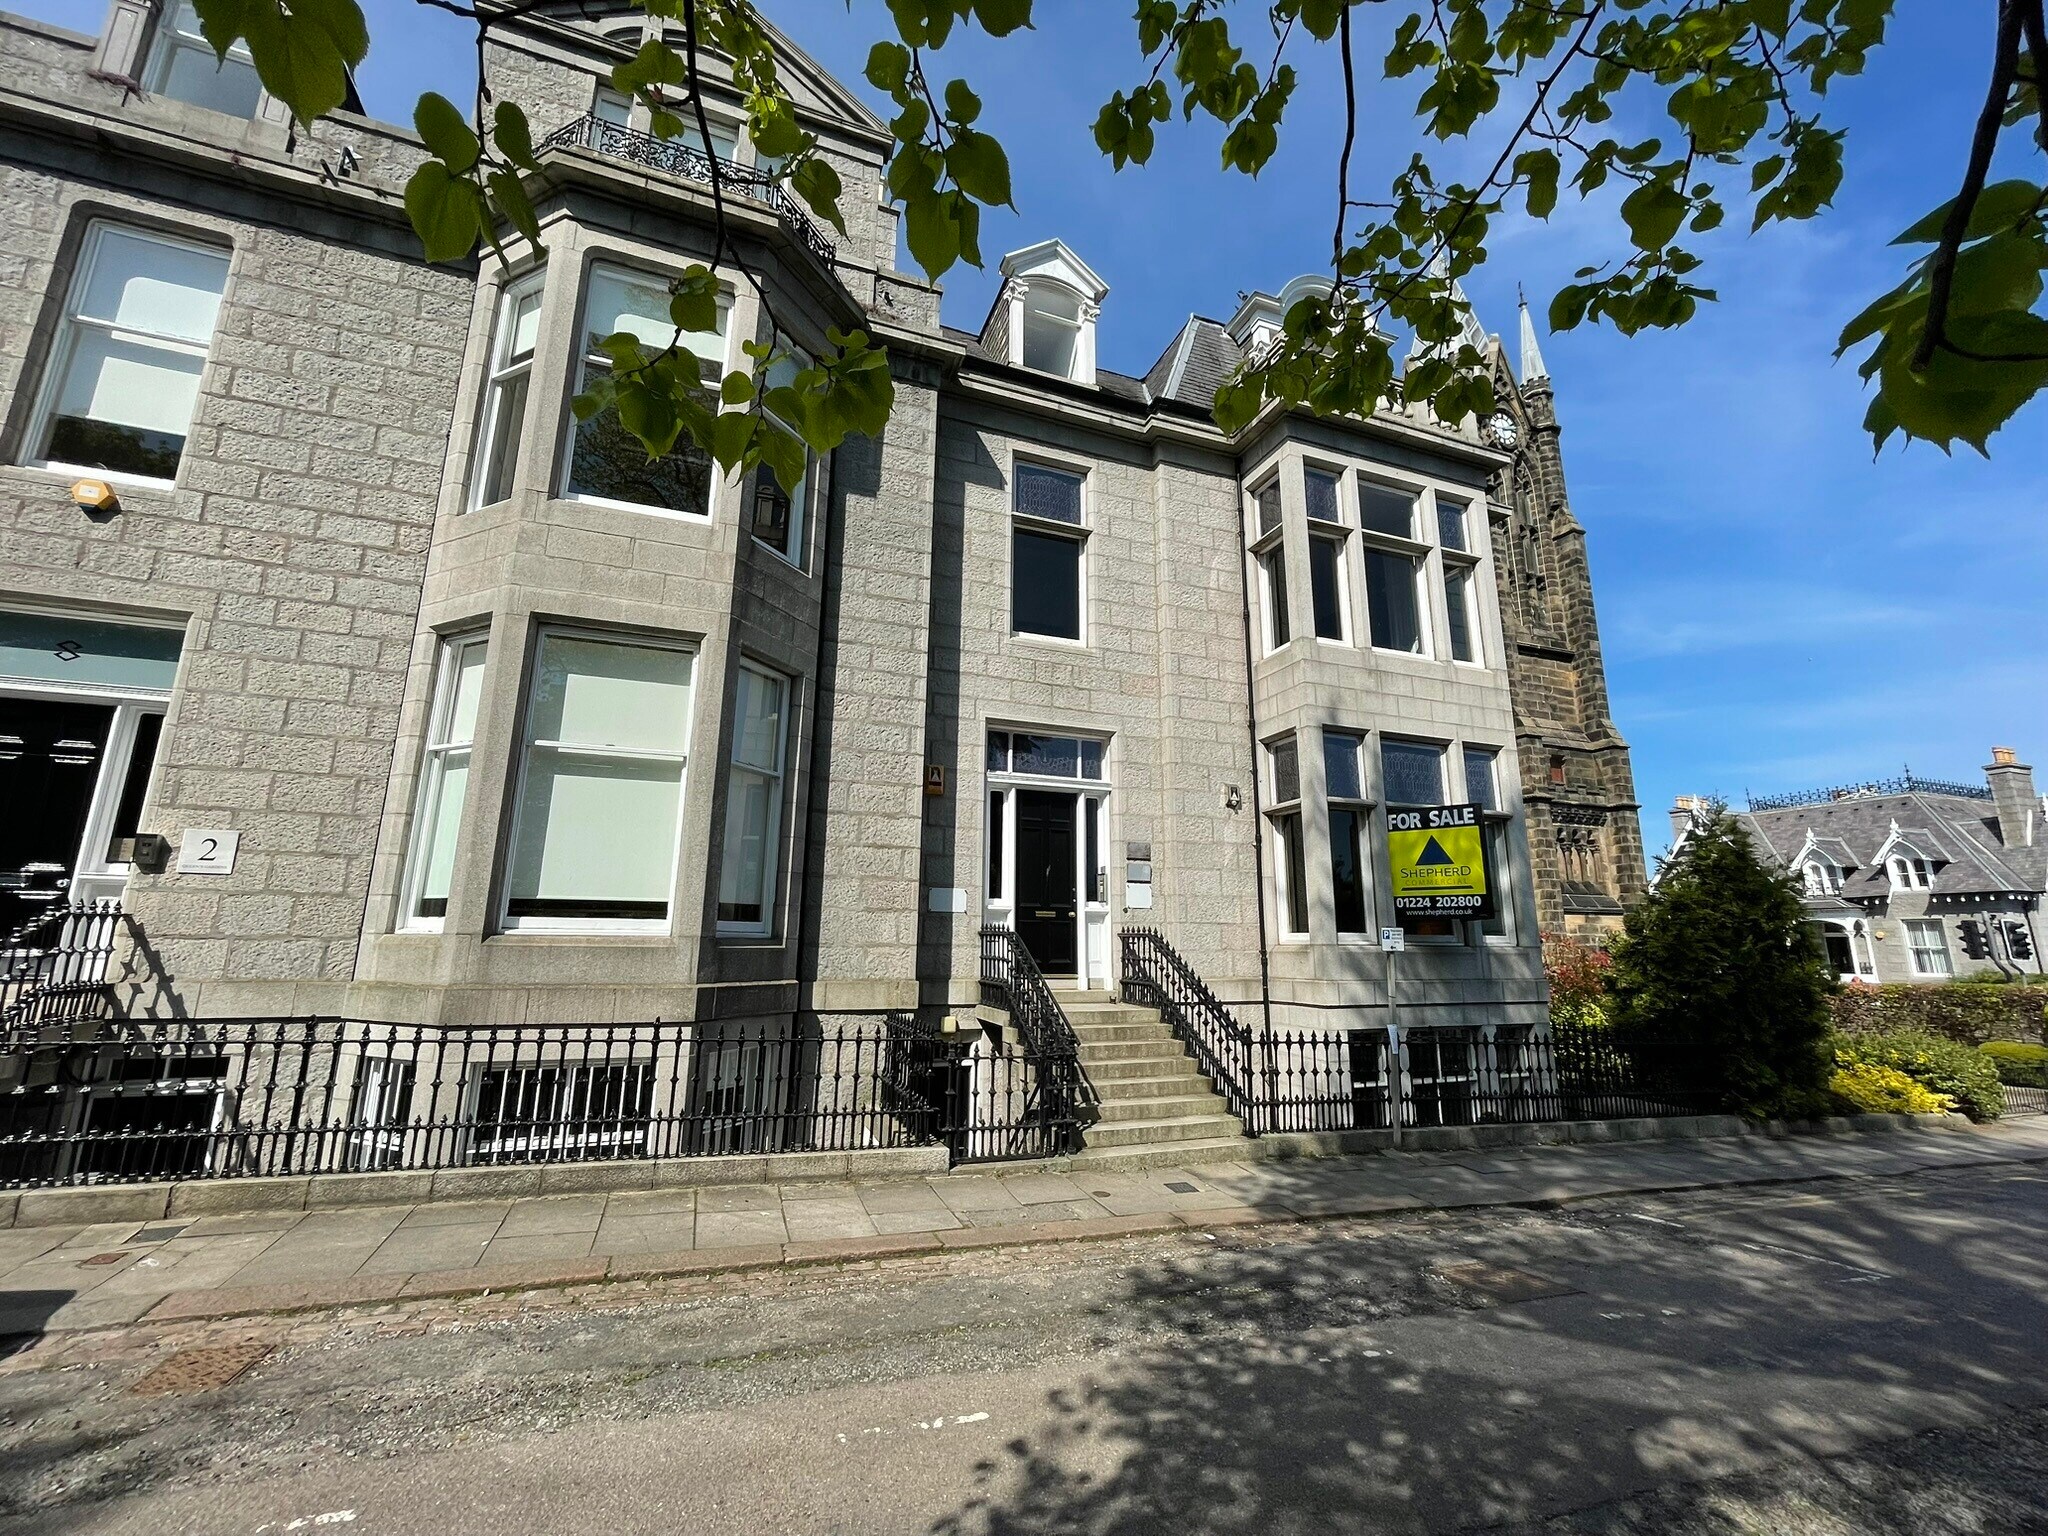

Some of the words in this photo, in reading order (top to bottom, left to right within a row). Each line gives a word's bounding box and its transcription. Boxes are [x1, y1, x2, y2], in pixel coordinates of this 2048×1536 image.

[1387, 812, 1422, 830] FOR
[1429, 807, 1475, 827] SALE
[197, 838, 217, 861] 2
[1400, 865, 1471, 878] SHEPHERD
[1405, 878, 1469, 886] COMMERCIAL
[1396, 897, 1432, 909] 01224
[1436, 895, 1482, 907] 202800
[1406, 908, 1473, 916] www.shepherd.co.uk
[1383, 930, 1389, 939] P
